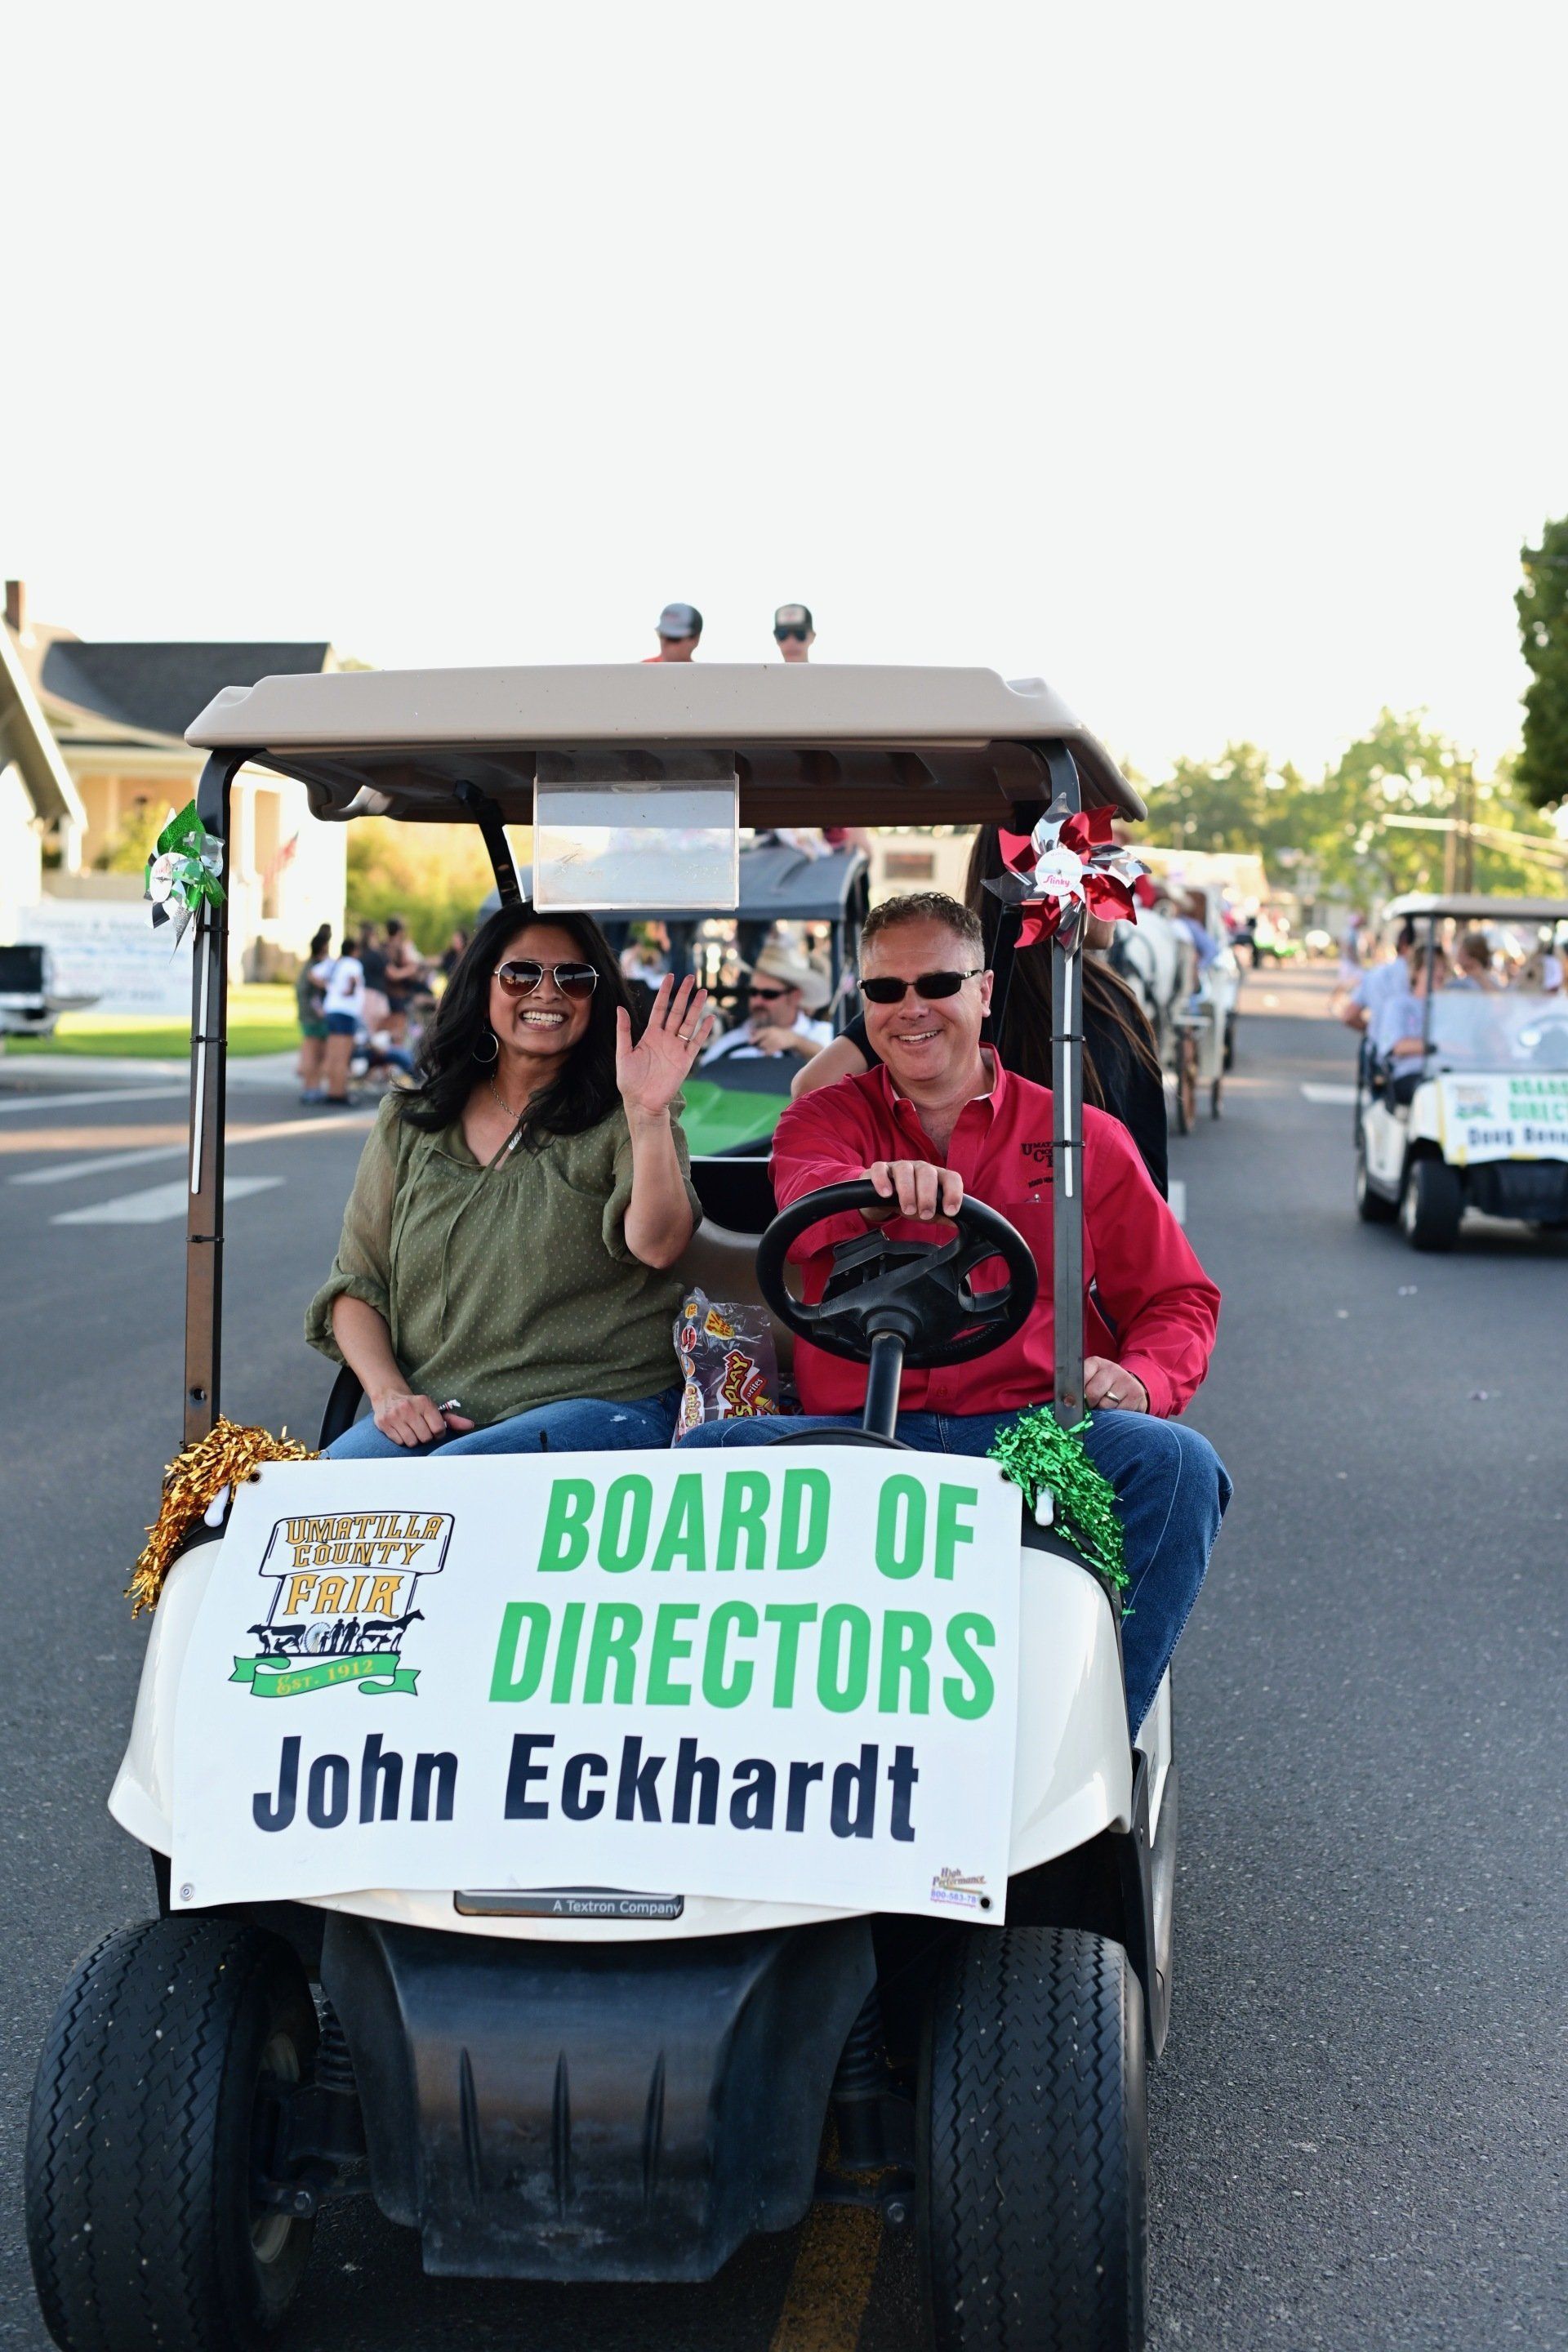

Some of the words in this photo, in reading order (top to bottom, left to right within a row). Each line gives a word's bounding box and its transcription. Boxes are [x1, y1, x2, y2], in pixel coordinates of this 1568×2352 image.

[1043, 875, 1070, 888] Slinky
[1021, 1142, 1053, 1156] UMAT
[725, 1356, 748, 1403] PLAY
[746, 1378, 764, 1398] orites
[285, 1515, 445, 1545] UMATILLA
[537, 1468, 831, 1574] BOARD
[875, 1473, 978, 1580] OF
[292, 1542, 425, 1567] COUNTY
[283, 1574, 405, 1619] FAIR
[327, 1659, 374, 1681] 1912
[488, 1600, 996, 1721] DIRECTORS
[252, 1733, 458, 1833] John
[504, 1733, 919, 1842] Eckhardt
[941, 1867, 961, 1878] High
[553, 1900, 563, 1912] A
[568, 1900, 615, 1913] Textron
[619, 1900, 682, 1916] Company
